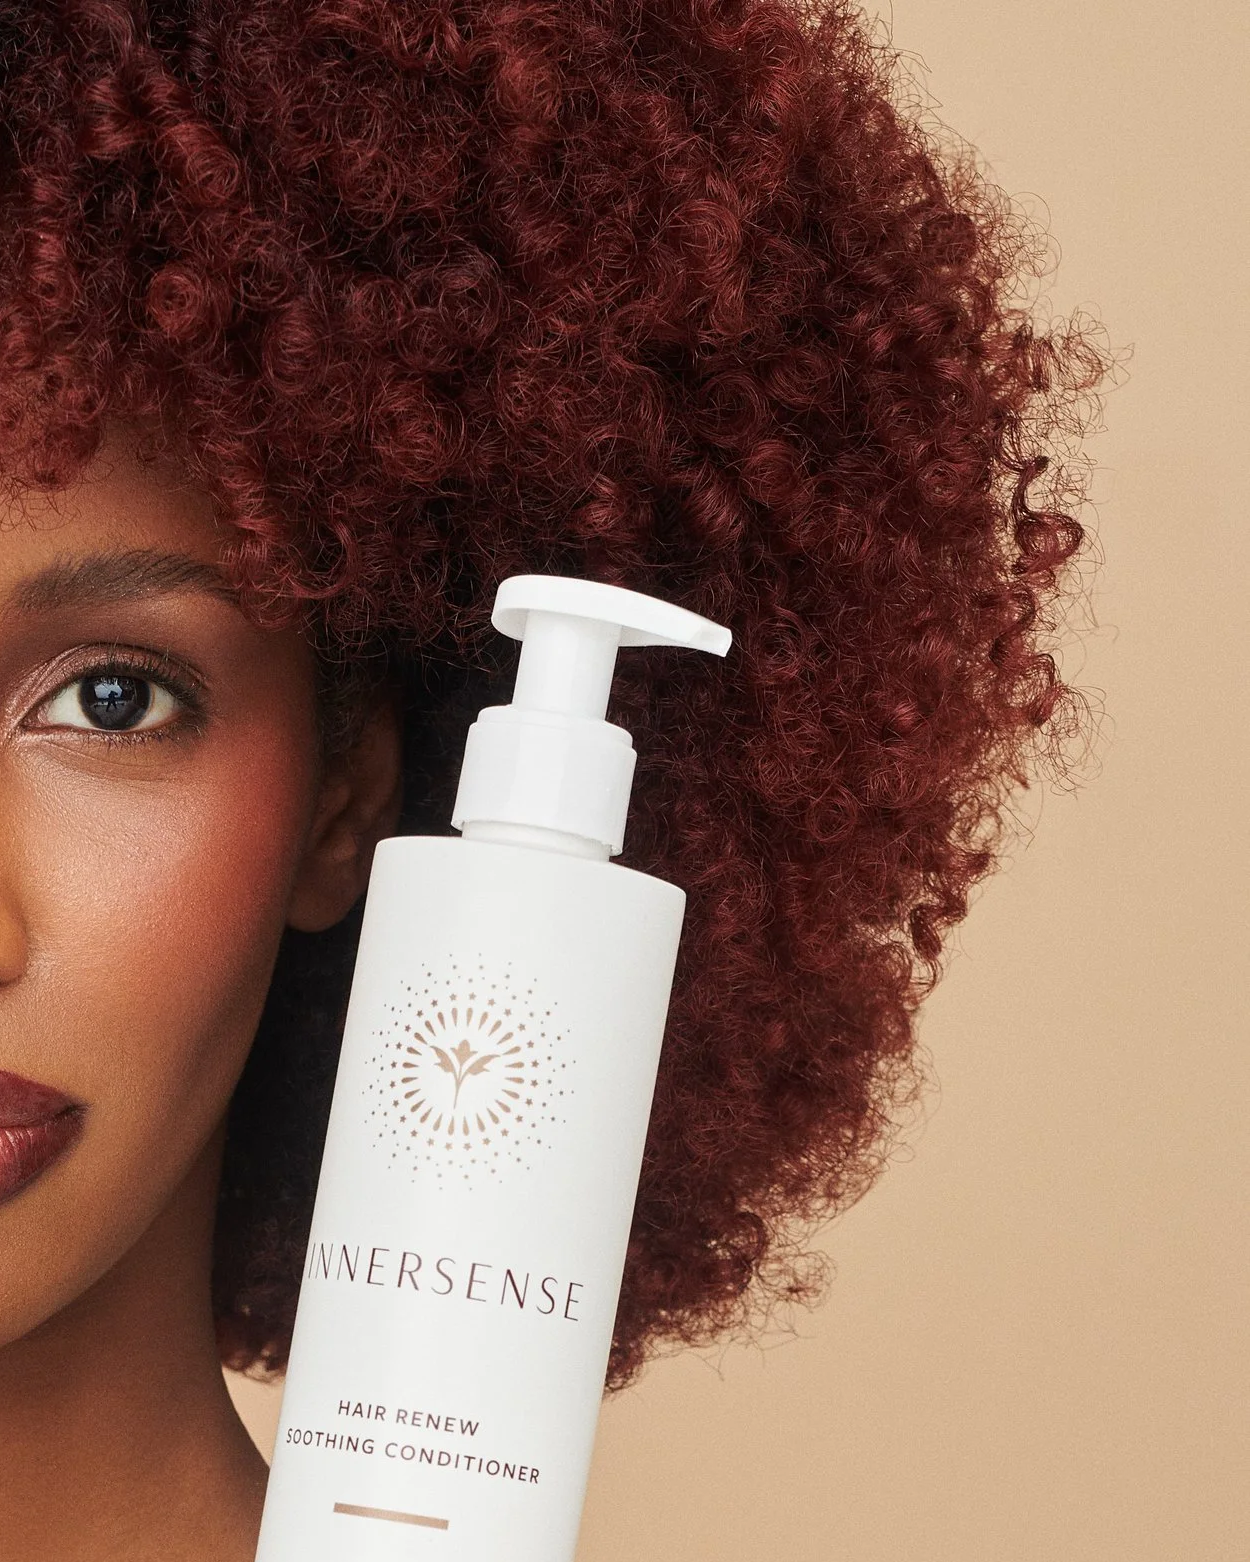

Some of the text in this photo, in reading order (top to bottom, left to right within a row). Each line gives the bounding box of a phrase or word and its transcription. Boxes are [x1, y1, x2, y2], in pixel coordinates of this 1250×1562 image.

[308, 1243, 584, 1322] INNERSENSE
[338, 1400, 480, 1436] HAIR RENEW
[286, 1428, 540, 1484] SOOTHING CONDITIONER
